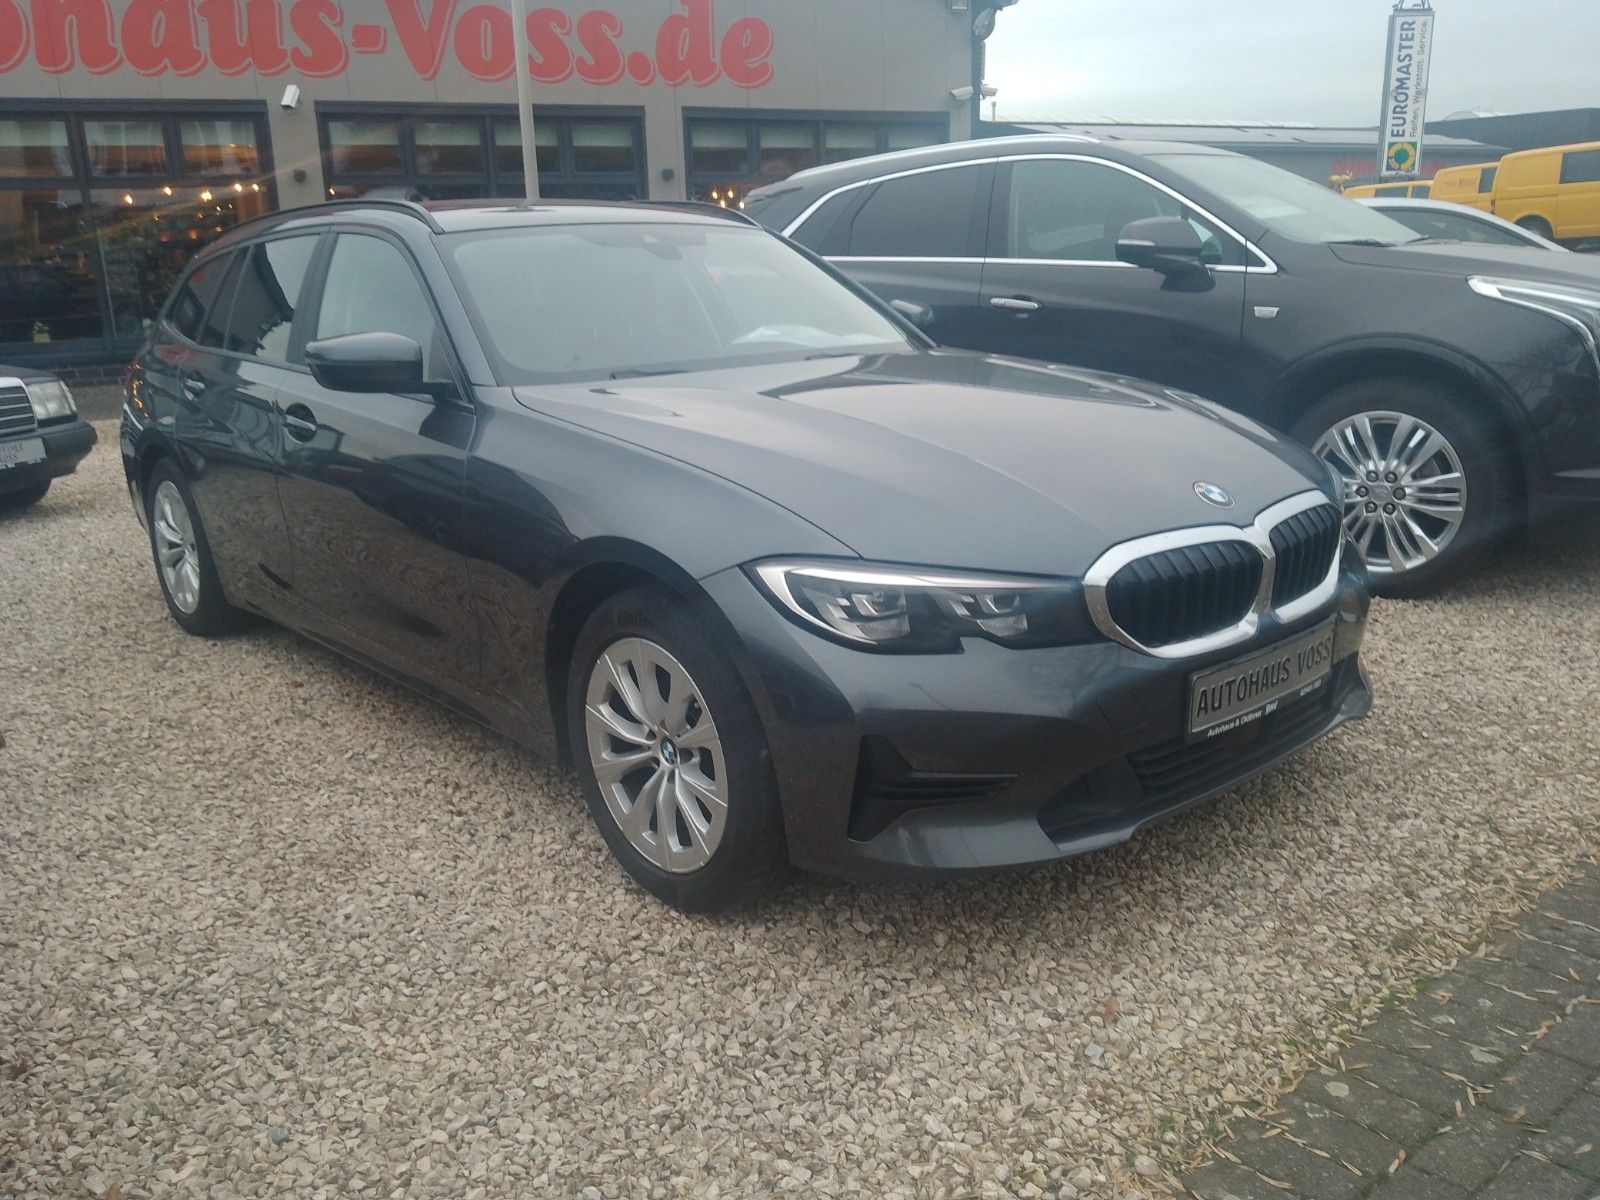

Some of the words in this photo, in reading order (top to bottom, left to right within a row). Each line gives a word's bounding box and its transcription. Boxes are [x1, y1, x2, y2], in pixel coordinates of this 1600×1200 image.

[1390, 19, 1416, 138] EUROMASTER
[1197, 656, 1291, 718] AUTOHAUS
[1297, 636, 1331, 675] VOSS
